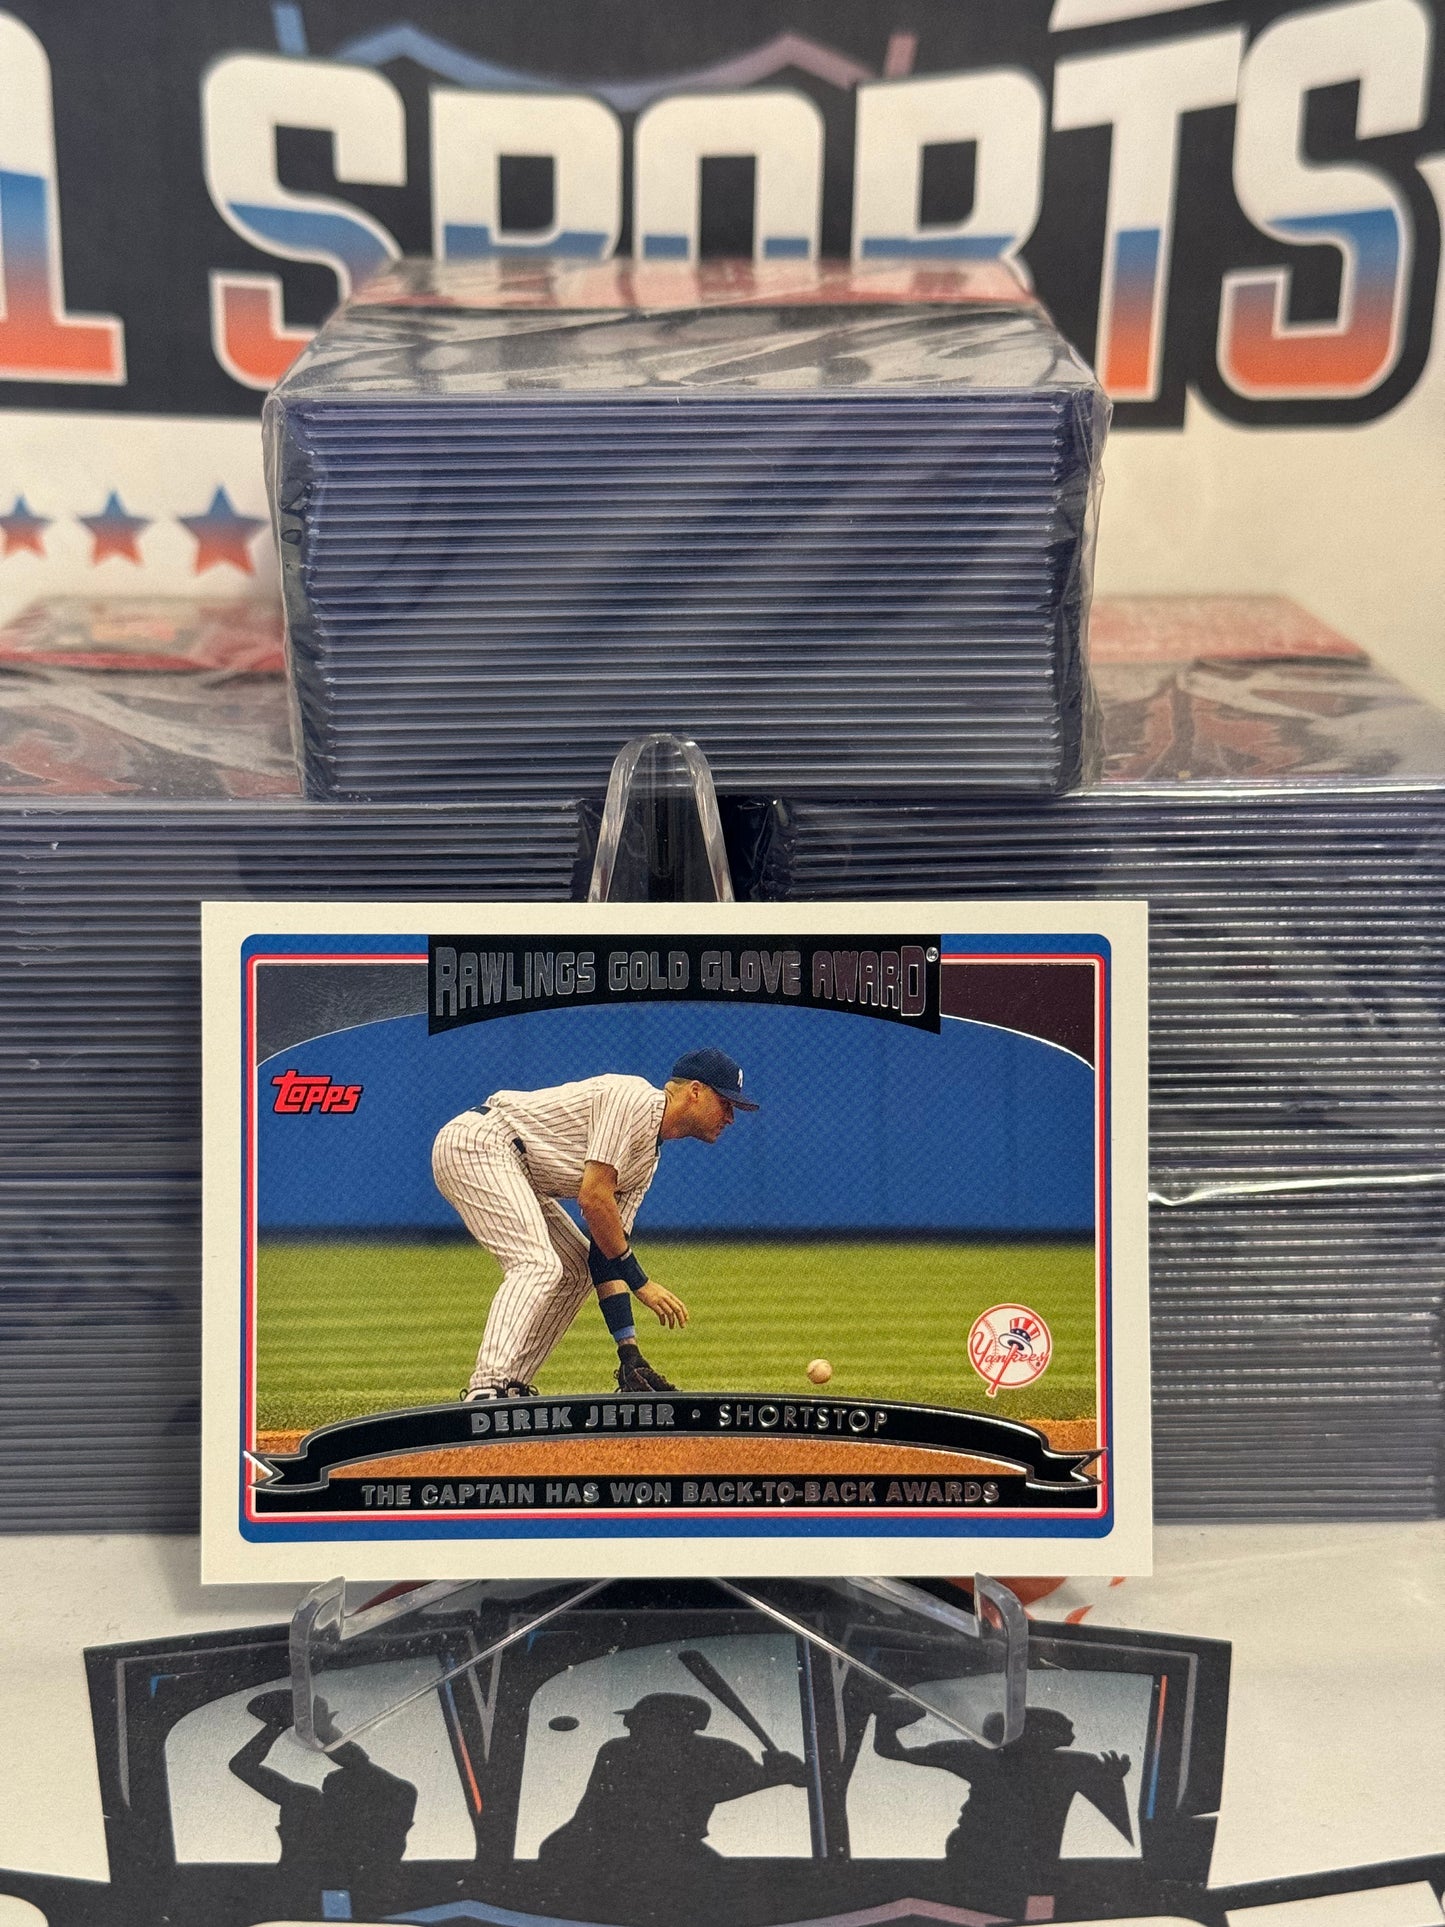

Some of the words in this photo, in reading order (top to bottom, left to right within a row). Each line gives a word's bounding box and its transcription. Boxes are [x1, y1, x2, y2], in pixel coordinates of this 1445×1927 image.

[435, 946, 595, 1017] RAWLINGS
[608, 951, 690, 991] GOLD
[701, 950, 801, 996] GLOVE
[271, 1069, 364, 1114] Topps
[970, 1331, 1050, 1368] Yankees
[470, 1405, 575, 1434] DEREK
[586, 1404, 676, 1428] JETER
[718, 1403, 889, 1432] SHORTSTOP
[361, 1484, 412, 1506] THE
[421, 1483, 536, 1506] CAPTAIN
[546, 1482, 600, 1504] HAS
[610, 1481, 673, 1504] WON
[681, 1481, 876, 1504] BACK-TO-BACK
[886, 1480, 1000, 1504] AWARDS
